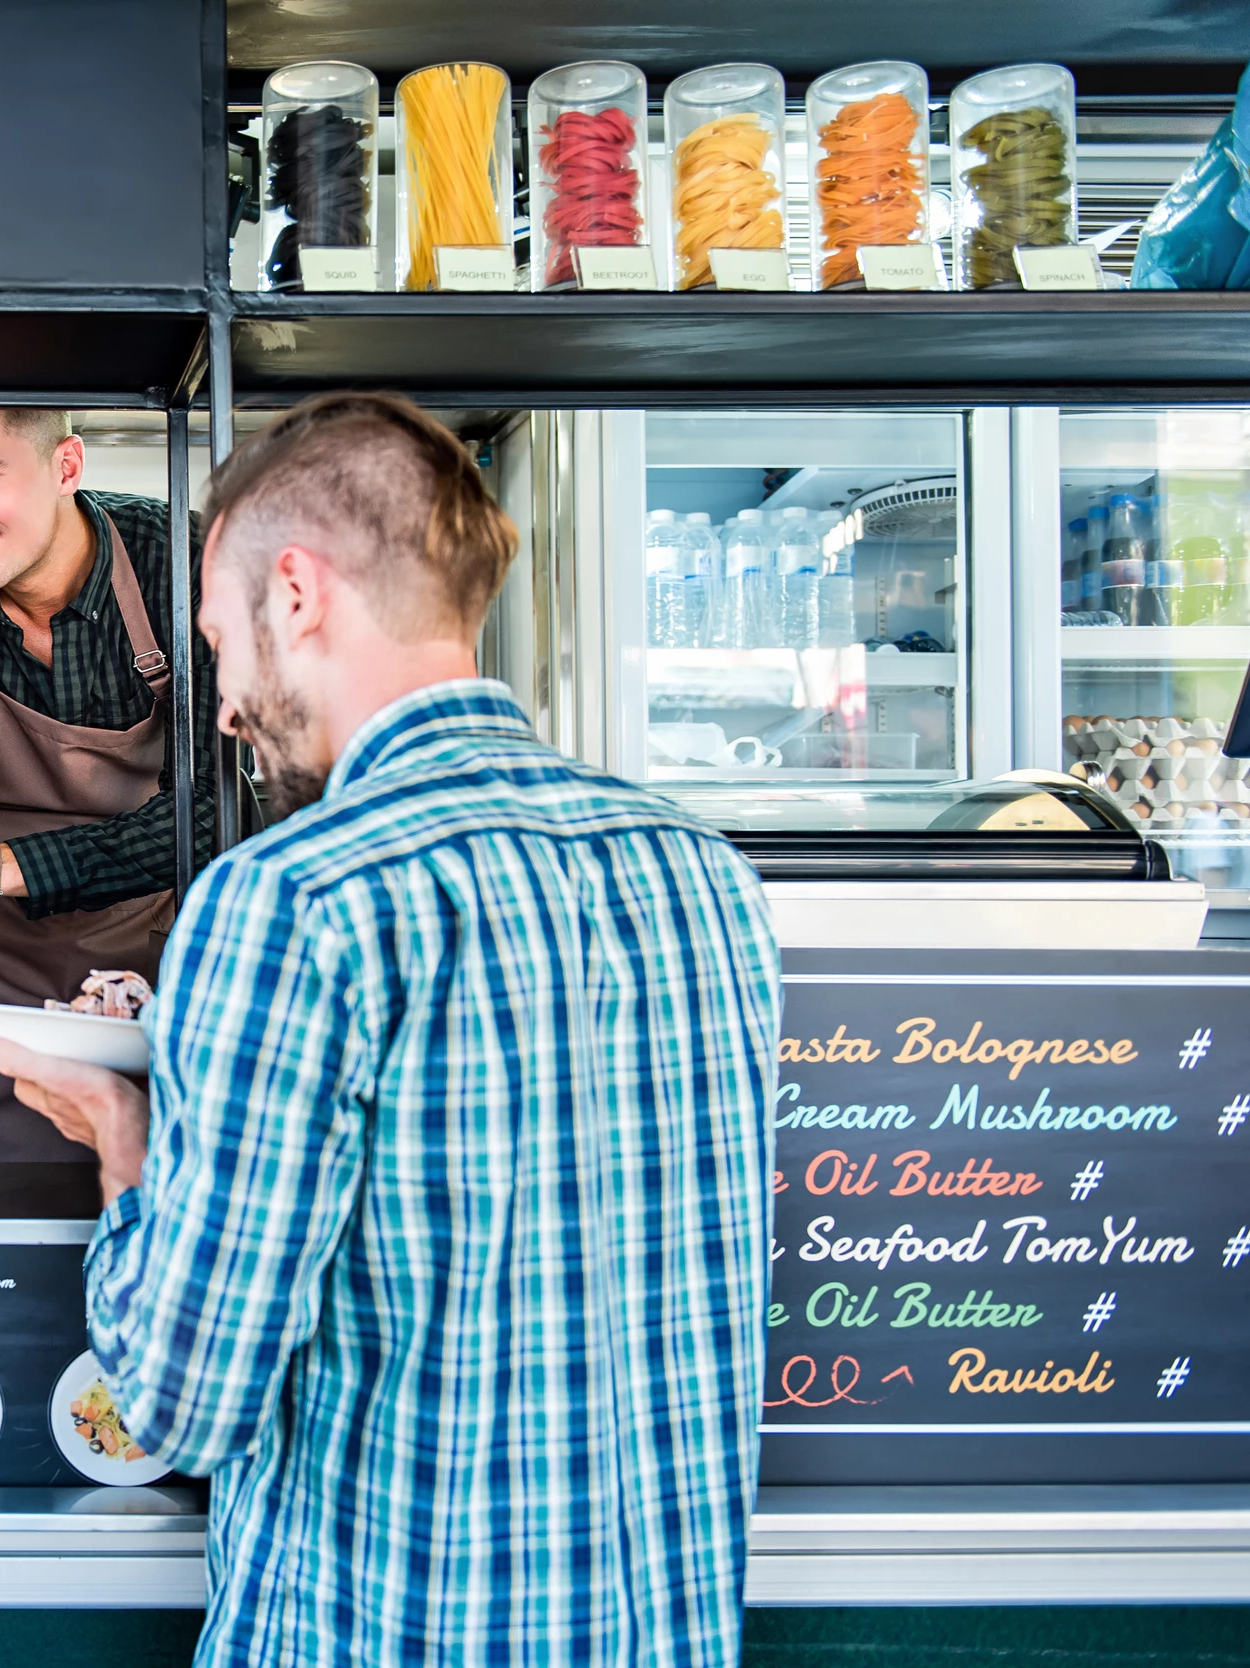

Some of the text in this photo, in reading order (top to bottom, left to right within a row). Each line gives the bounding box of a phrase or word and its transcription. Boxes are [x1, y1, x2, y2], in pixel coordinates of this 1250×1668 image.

[324, 271, 357, 279] SQUID
[448, 270, 506, 280] SPAGHETTI
[592, 271, 649, 279] BEETROOT
[742, 273, 766, 282] EGG
[880, 268, 924, 276] TOMATO
[1039, 273, 1085, 282] SPINACH
[776, 1024, 881, 1063] asta
[892, 1017, 1139, 1081] Bolognese
[772, 1082, 916, 1129] Cream
[929, 1083, 1178, 1130] Mushroom
[805, 1149, 879, 1196] Oil
[889, 1149, 1043, 1196] Butter
[798, 1215, 989, 1271] Seafood
[1002, 1215, 1195, 1265] TomYum
[805, 1281, 879, 1328] Oil
[889, 1281, 1043, 1328] Butter
[948, 1347, 1116, 1394] Ravioli
